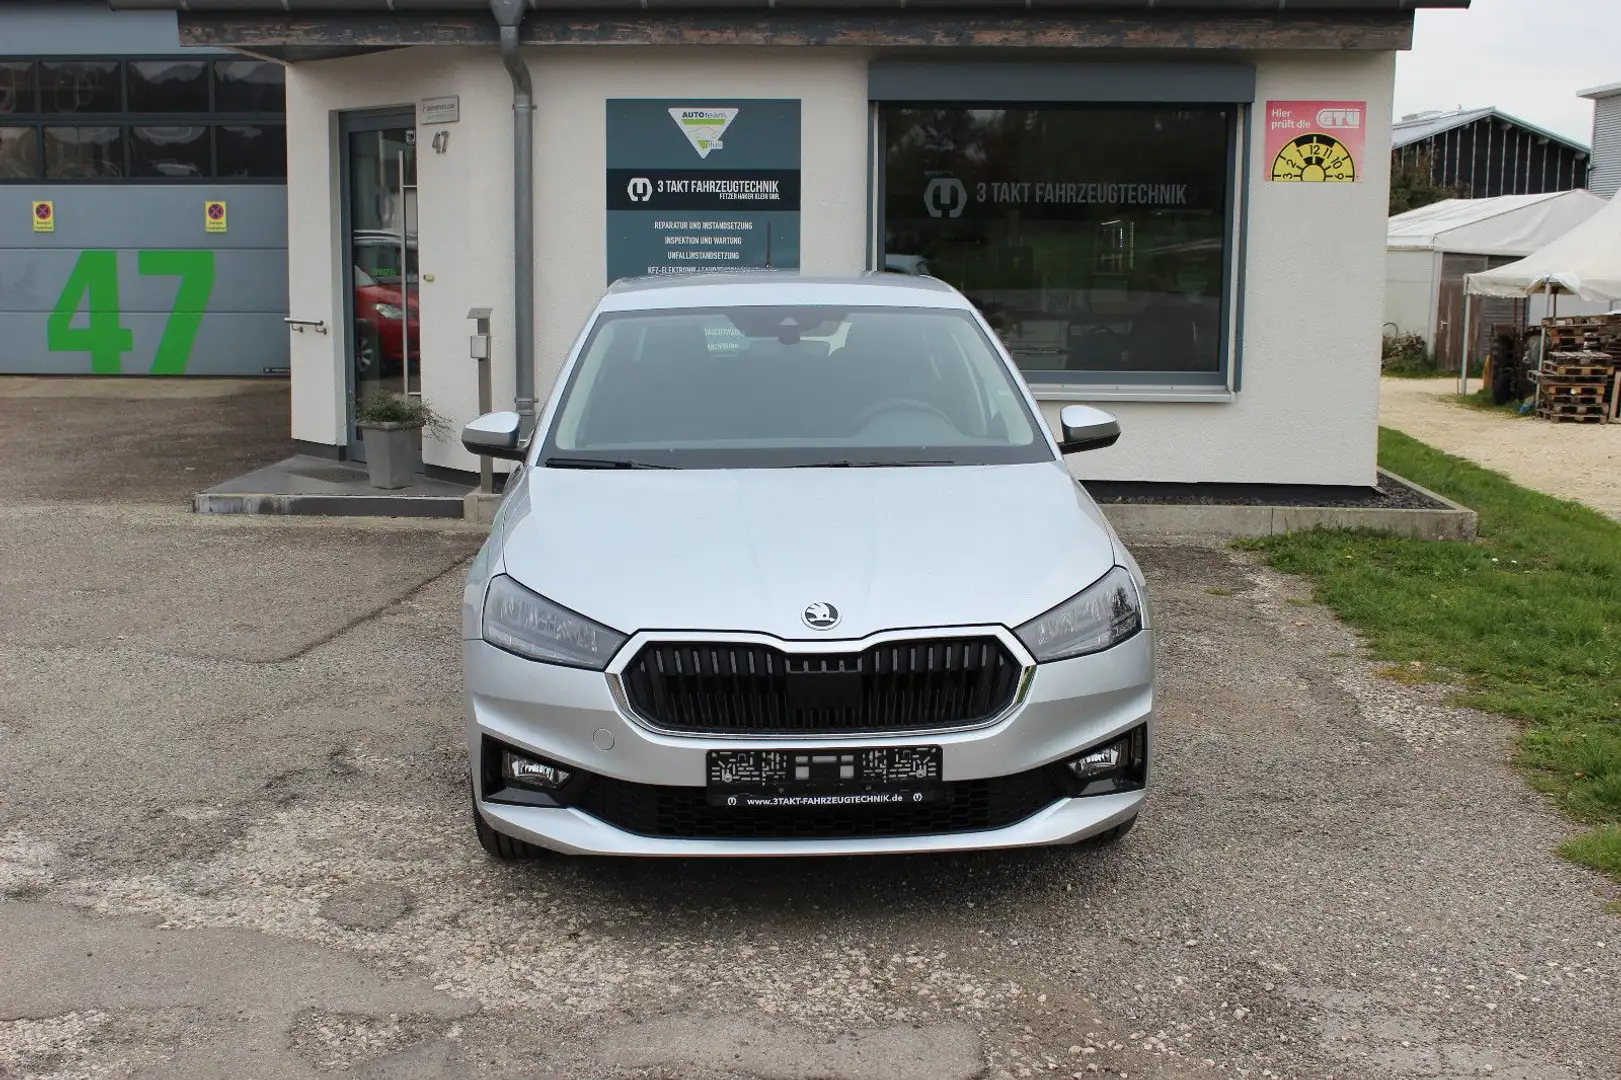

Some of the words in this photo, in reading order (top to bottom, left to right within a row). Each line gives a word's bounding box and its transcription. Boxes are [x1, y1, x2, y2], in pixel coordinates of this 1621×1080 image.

[1271, 108, 1292, 118] Hier
[1317, 108, 1360, 127] GTÜ
[1271, 119, 1295, 131] prüft
[1296, 119, 1312, 129] die
[432, 130, 450, 154] 47
[1309, 144, 1321, 155] 12
[1323, 148, 1333, 159] 11
[657, 180, 664, 193] 3
[666, 181, 690, 193] TAKT
[691, 181, 779, 193] FAHRZEUGTECHNIK
[976, 182, 987, 203] 3
[990, 182, 1033, 203] TAKT
[1035, 183, 1187, 205] FAHRZEUGTECHNIK
[654, 221, 688, 230] REPARATUR
[688, 221, 701, 230] UND
[702, 221, 753, 230] INSTANDSETZUNG
[664, 236, 699, 245] INSPEKTION
[700, 236, 712, 245] UND
[713, 236, 742, 245] WARTUNG
[667, 251, 740, 260] UNFALLINSTANDSETZUNG
[47, 250, 215, 374] 47
[747, 794, 903, 806] www.3TAKT-FAHRZEUGTECHNIK.de
